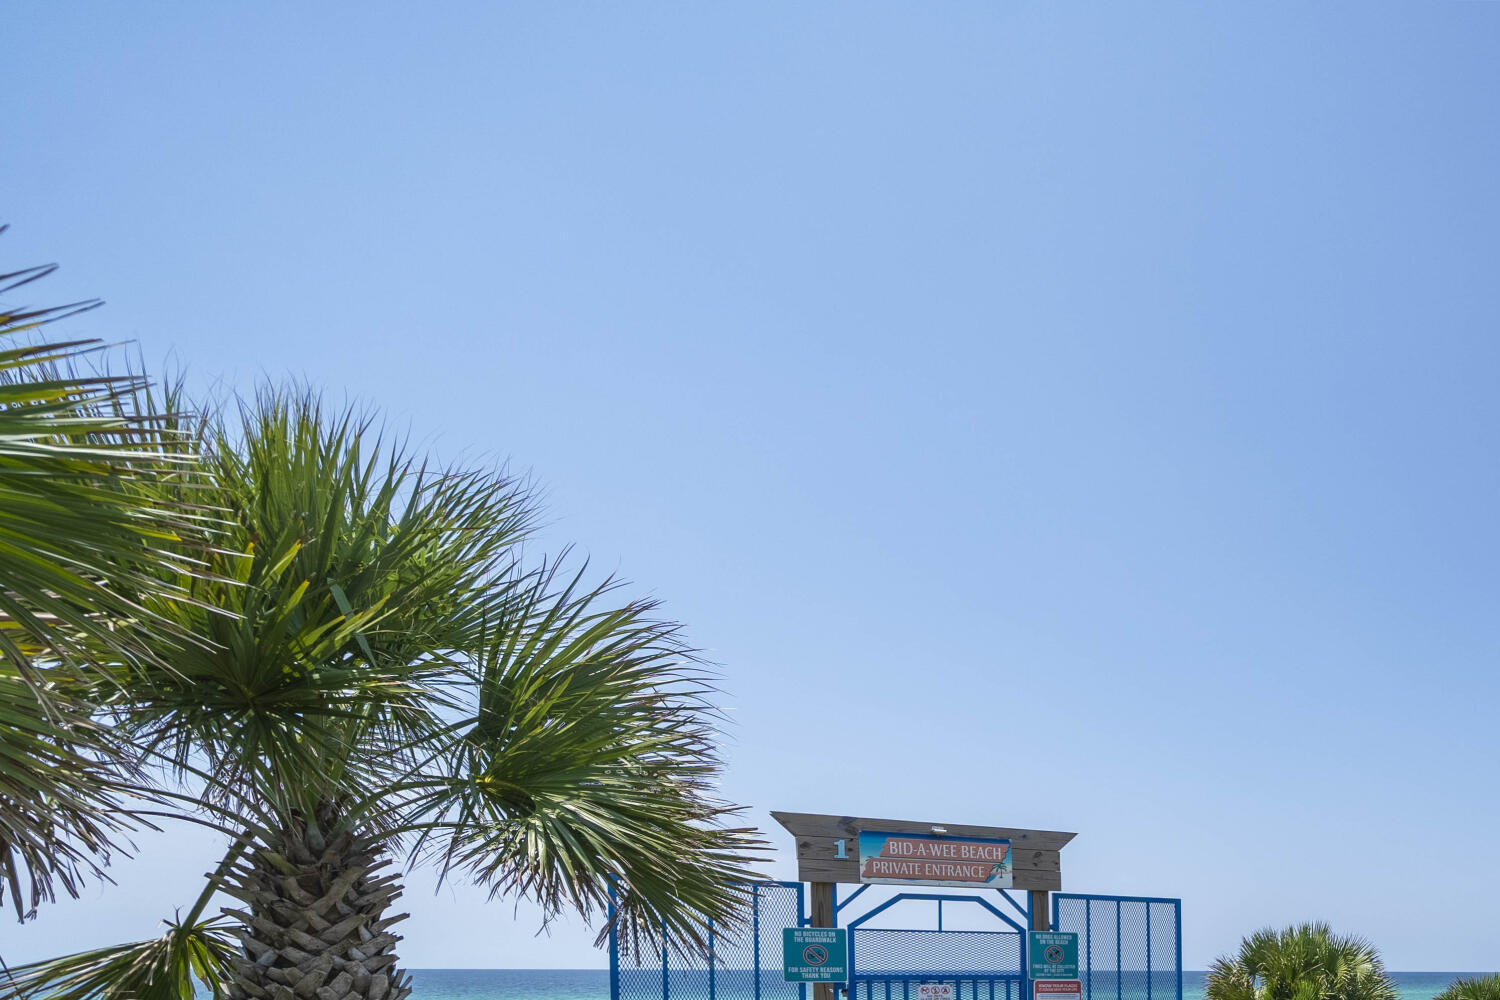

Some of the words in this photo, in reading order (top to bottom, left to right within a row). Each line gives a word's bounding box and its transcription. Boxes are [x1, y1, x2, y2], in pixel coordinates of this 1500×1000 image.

[833, 839, 849, 859] 1
[889, 841, 957, 857] BID-A-WEE
[961, 846, 1002, 860] BEACH
[872, 861, 921, 875] PRIVATE
[925, 863, 985, 878] ENTRANCE
